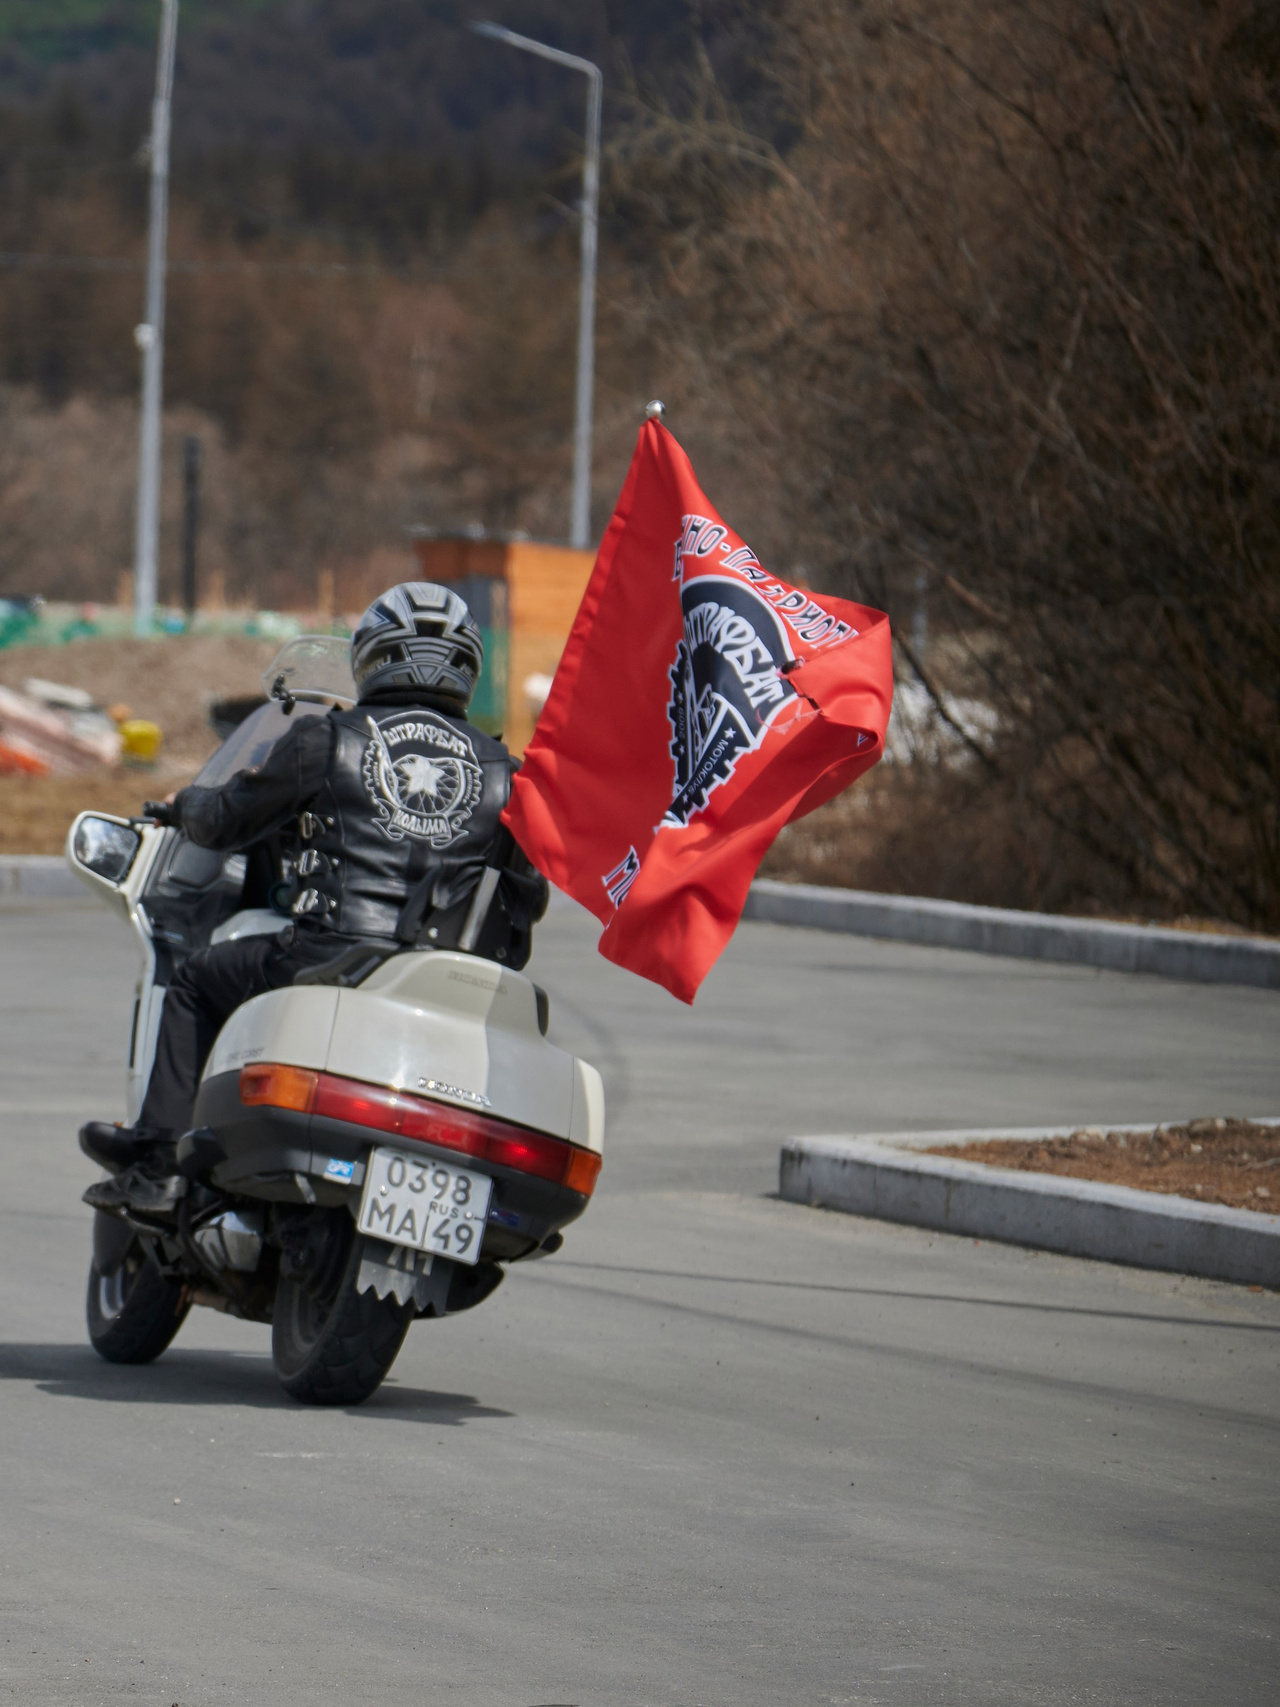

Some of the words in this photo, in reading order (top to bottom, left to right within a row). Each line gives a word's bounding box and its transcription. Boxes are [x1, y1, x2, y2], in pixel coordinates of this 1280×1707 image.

[382, 722, 468, 757] ШТРАФБАТ
[687, 738, 729, 795] МОТОКЛУБ
[394, 809, 448, 834] КОЛЫМА
[418, 1077, 492, 1107] HONDA
[387, 1155, 472, 1206] 0398
[429, 1201, 459, 1219] RUS
[432, 1218, 474, 1254] 49
